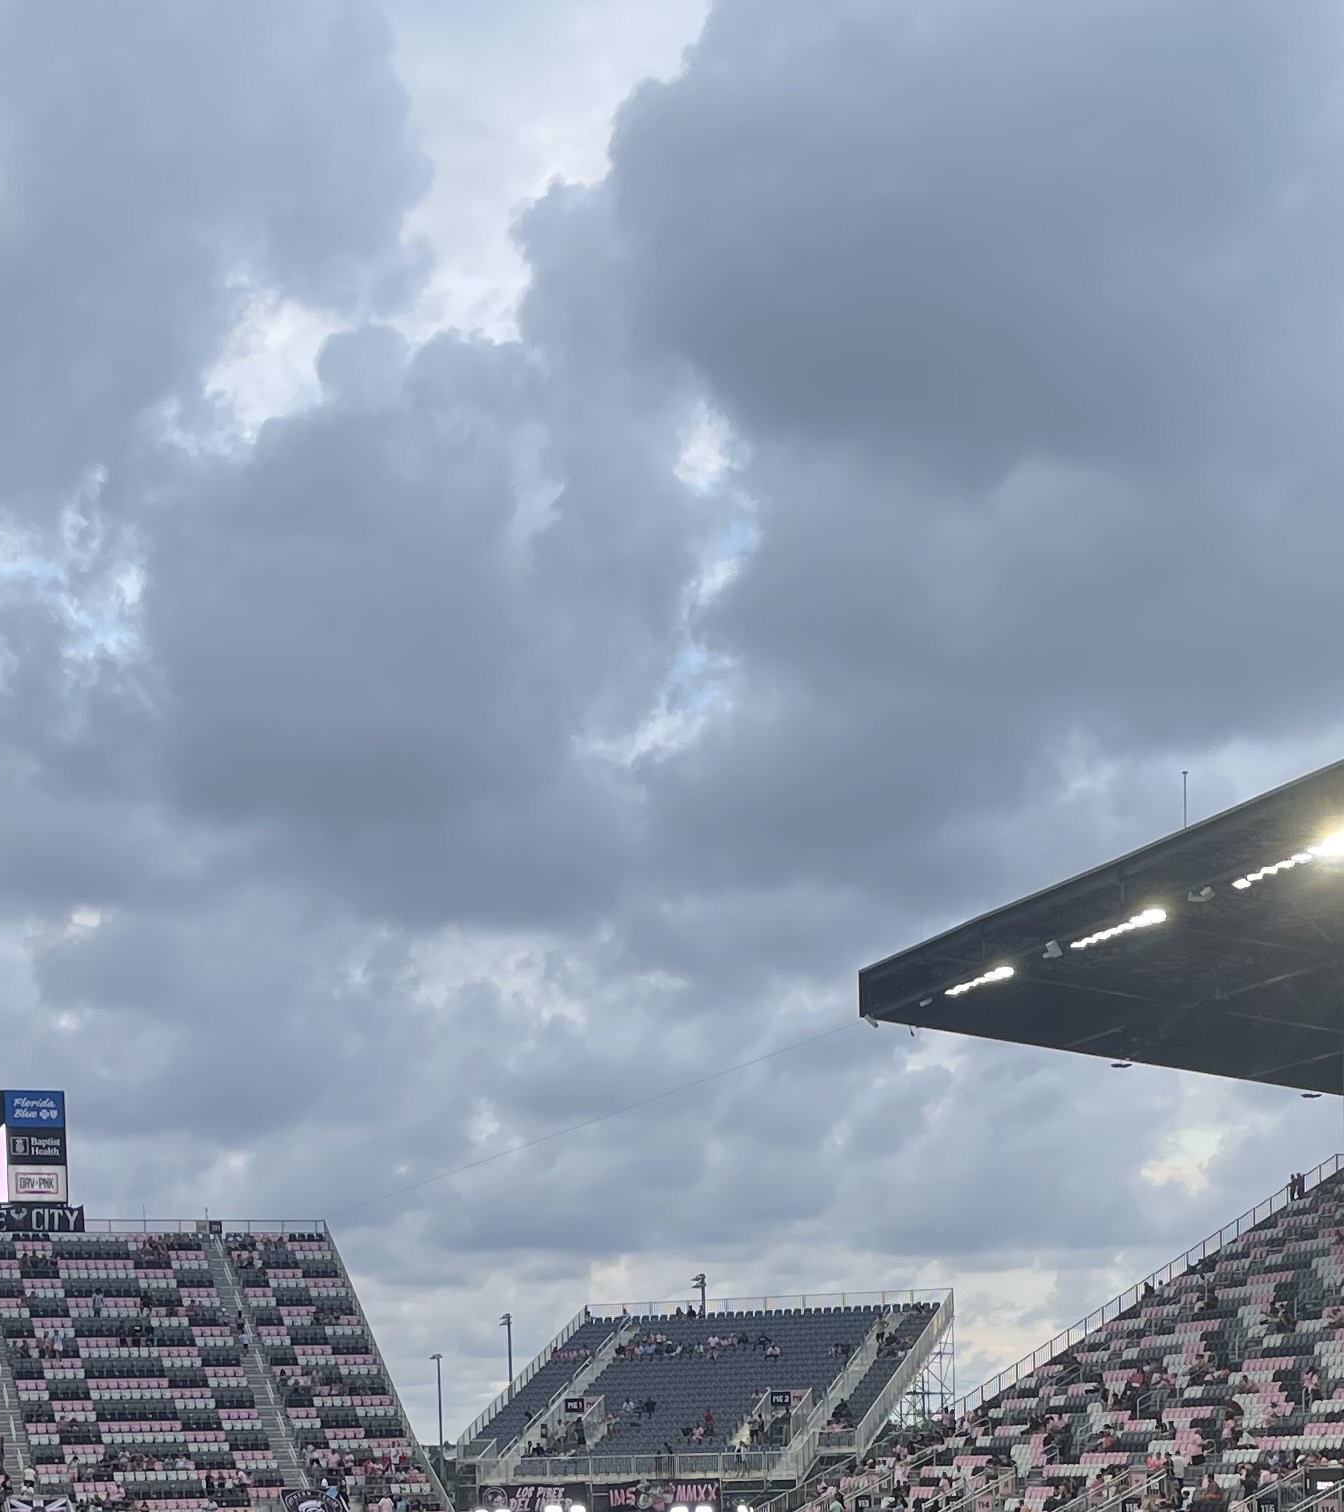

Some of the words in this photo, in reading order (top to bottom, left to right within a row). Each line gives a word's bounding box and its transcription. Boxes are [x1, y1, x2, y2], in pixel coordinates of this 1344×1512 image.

[13, 1097, 56, 1108] Florida
[13, 1108, 38, 1119] Blue
[31, 1137, 61, 1148] Baptist
[31, 1146, 61, 1156] Health
[31, 1208, 80, 1232] CITY
[515, 1486, 534, 1499] LOS
[674, 1482, 718, 1503] MMXX
[509, 1497, 534, 1512] DEL
